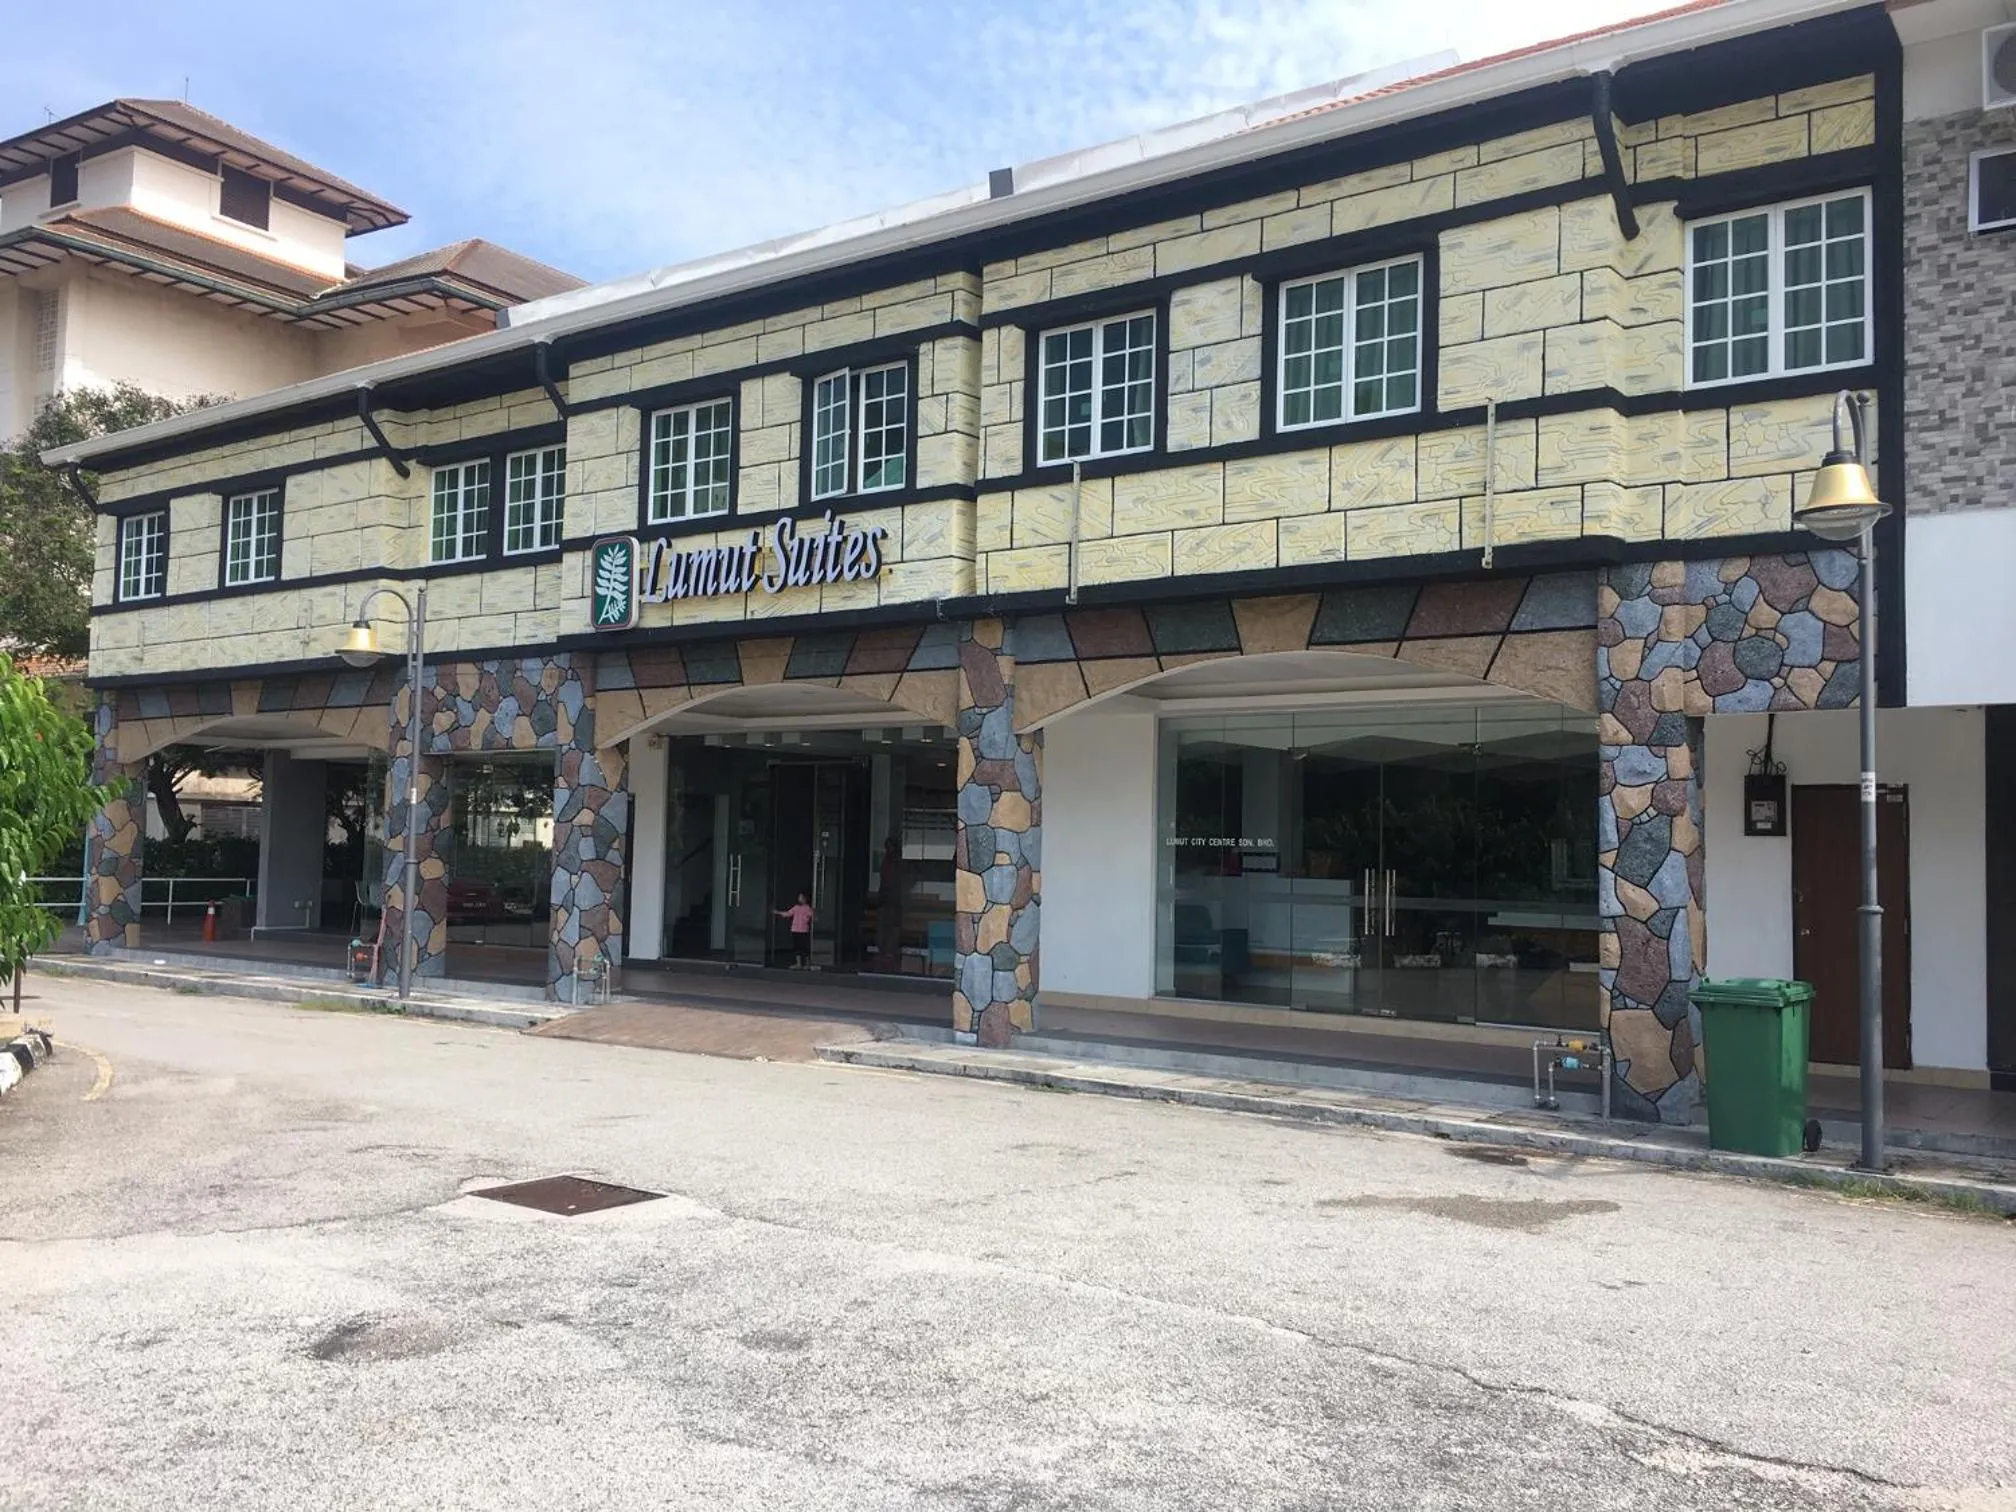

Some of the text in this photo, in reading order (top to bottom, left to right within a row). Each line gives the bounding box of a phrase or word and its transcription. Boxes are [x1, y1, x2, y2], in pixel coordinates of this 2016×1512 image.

[643, 509, 887, 603] Lumut Suites
[1191, 838, 1206, 846] CITY
[1209, 838, 1236, 847] CENTRE
